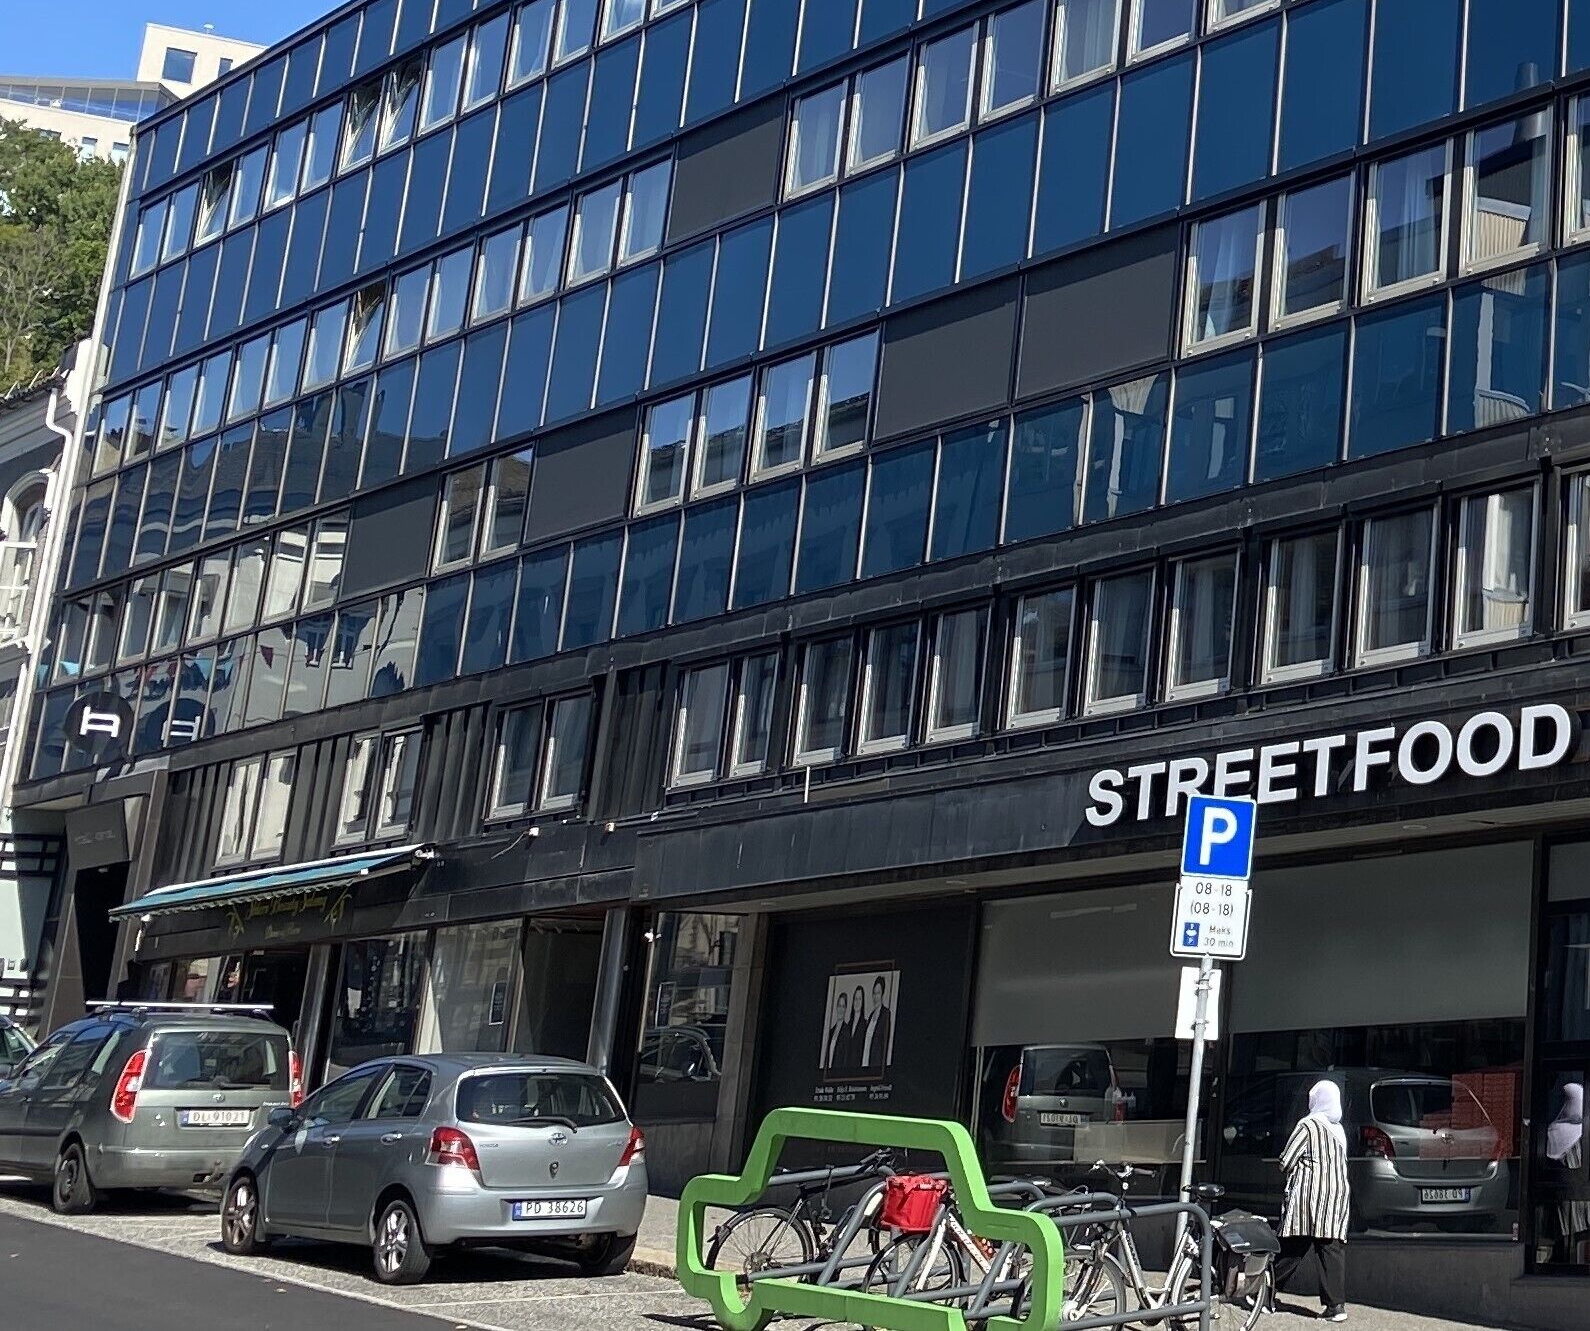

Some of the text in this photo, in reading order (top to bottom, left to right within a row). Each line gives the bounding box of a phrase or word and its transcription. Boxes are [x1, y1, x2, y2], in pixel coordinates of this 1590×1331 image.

[1199, 806, 1238, 866] P
[1203, 937, 1216, 947] 30
[213, 1111, 245, 1122] 91021
[526, 1200, 584, 1215] PD 38626
